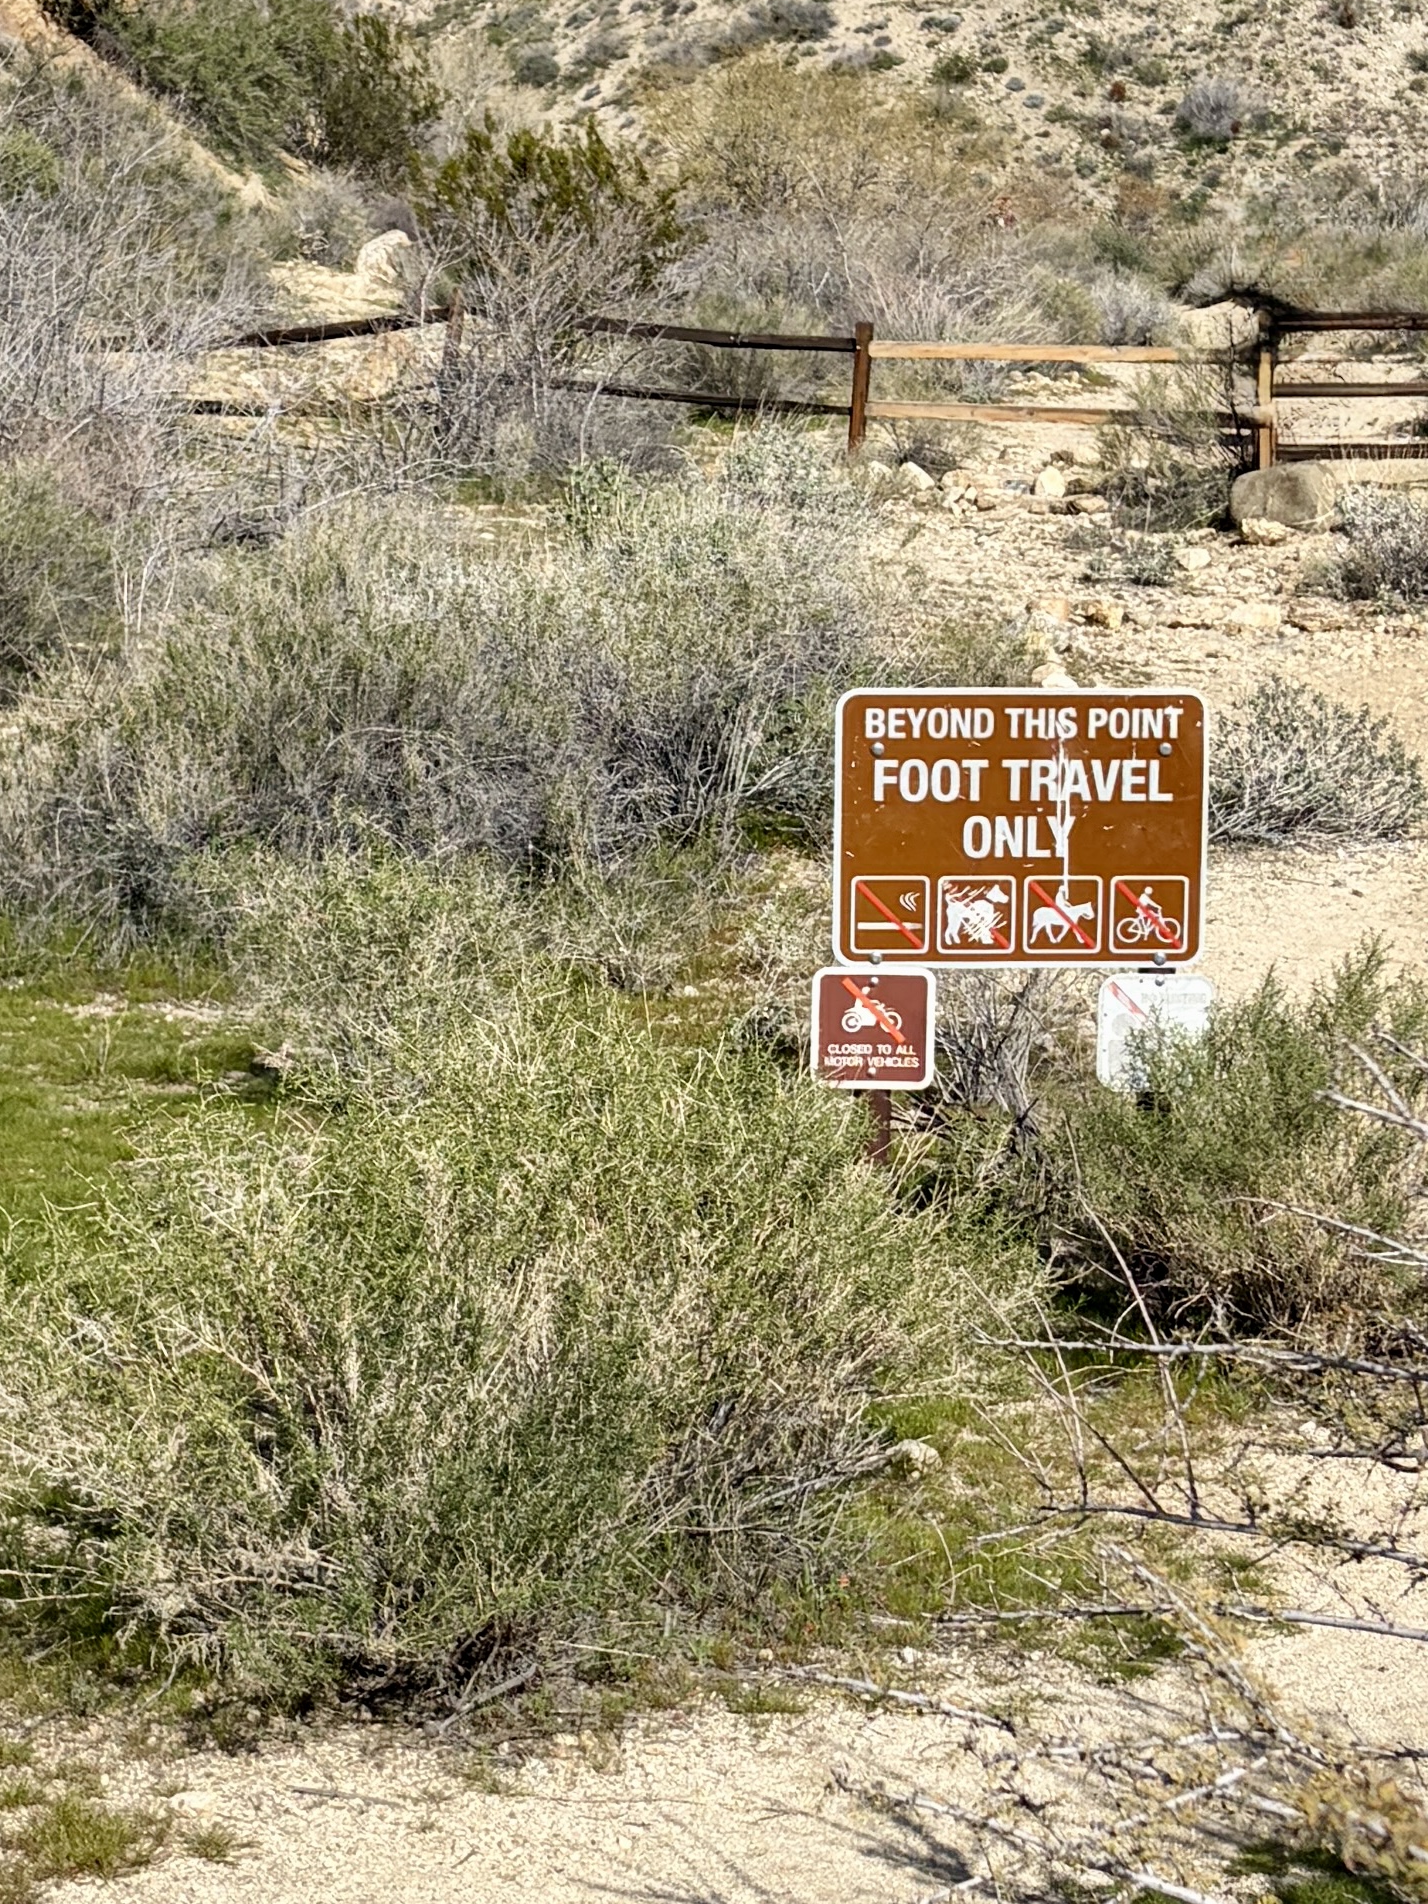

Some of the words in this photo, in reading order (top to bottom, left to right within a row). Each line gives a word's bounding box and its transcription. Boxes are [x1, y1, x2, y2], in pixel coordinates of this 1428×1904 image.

[865, 708, 995, 739] BEYOND
[1004, 707, 1078, 740] THIS
[1087, 707, 1184, 739] POINT
[874, 759, 989, 802] FOOT
[1001, 759, 1174, 802] TRAVEL
[963, 815, 1076, 859] ONLY
[824, 1056, 864, 1066] MOTOR
[867, 1056, 920, 1068] VEHICLES
[827, 1044, 873, 1055] CLOSED
[876, 1044, 892, 1055] TO
[895, 1044, 917, 1056] ALL
